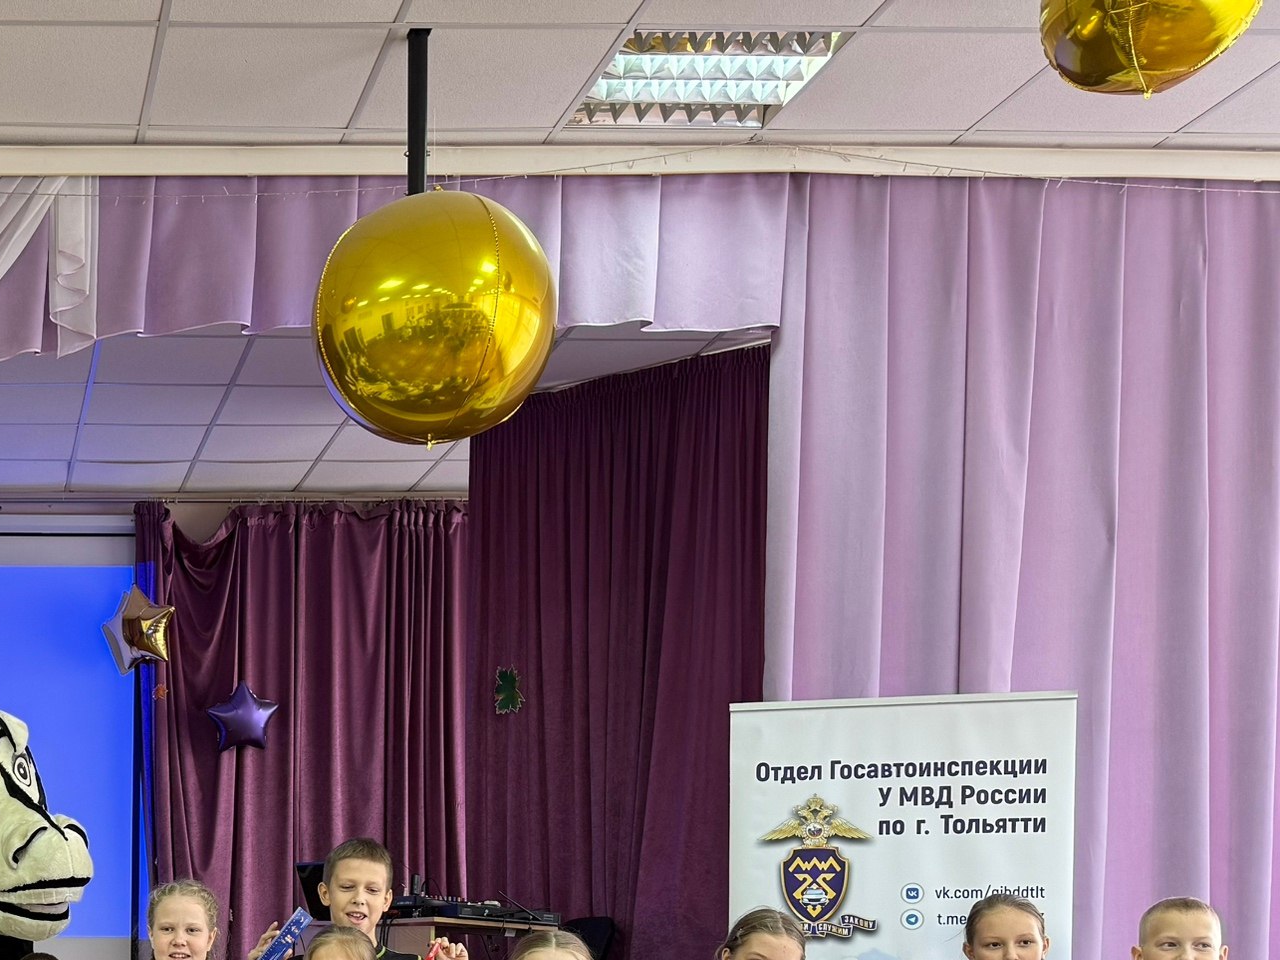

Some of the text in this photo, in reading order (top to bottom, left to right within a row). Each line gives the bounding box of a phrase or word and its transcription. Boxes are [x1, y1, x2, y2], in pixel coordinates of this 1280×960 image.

[756, 758, 1047, 784] Отдел Госавтоинспекции
[899, 786, 953, 808] МВД
[961, 785, 1047, 805] России
[878, 814, 1046, 835] по г. Тольятти
